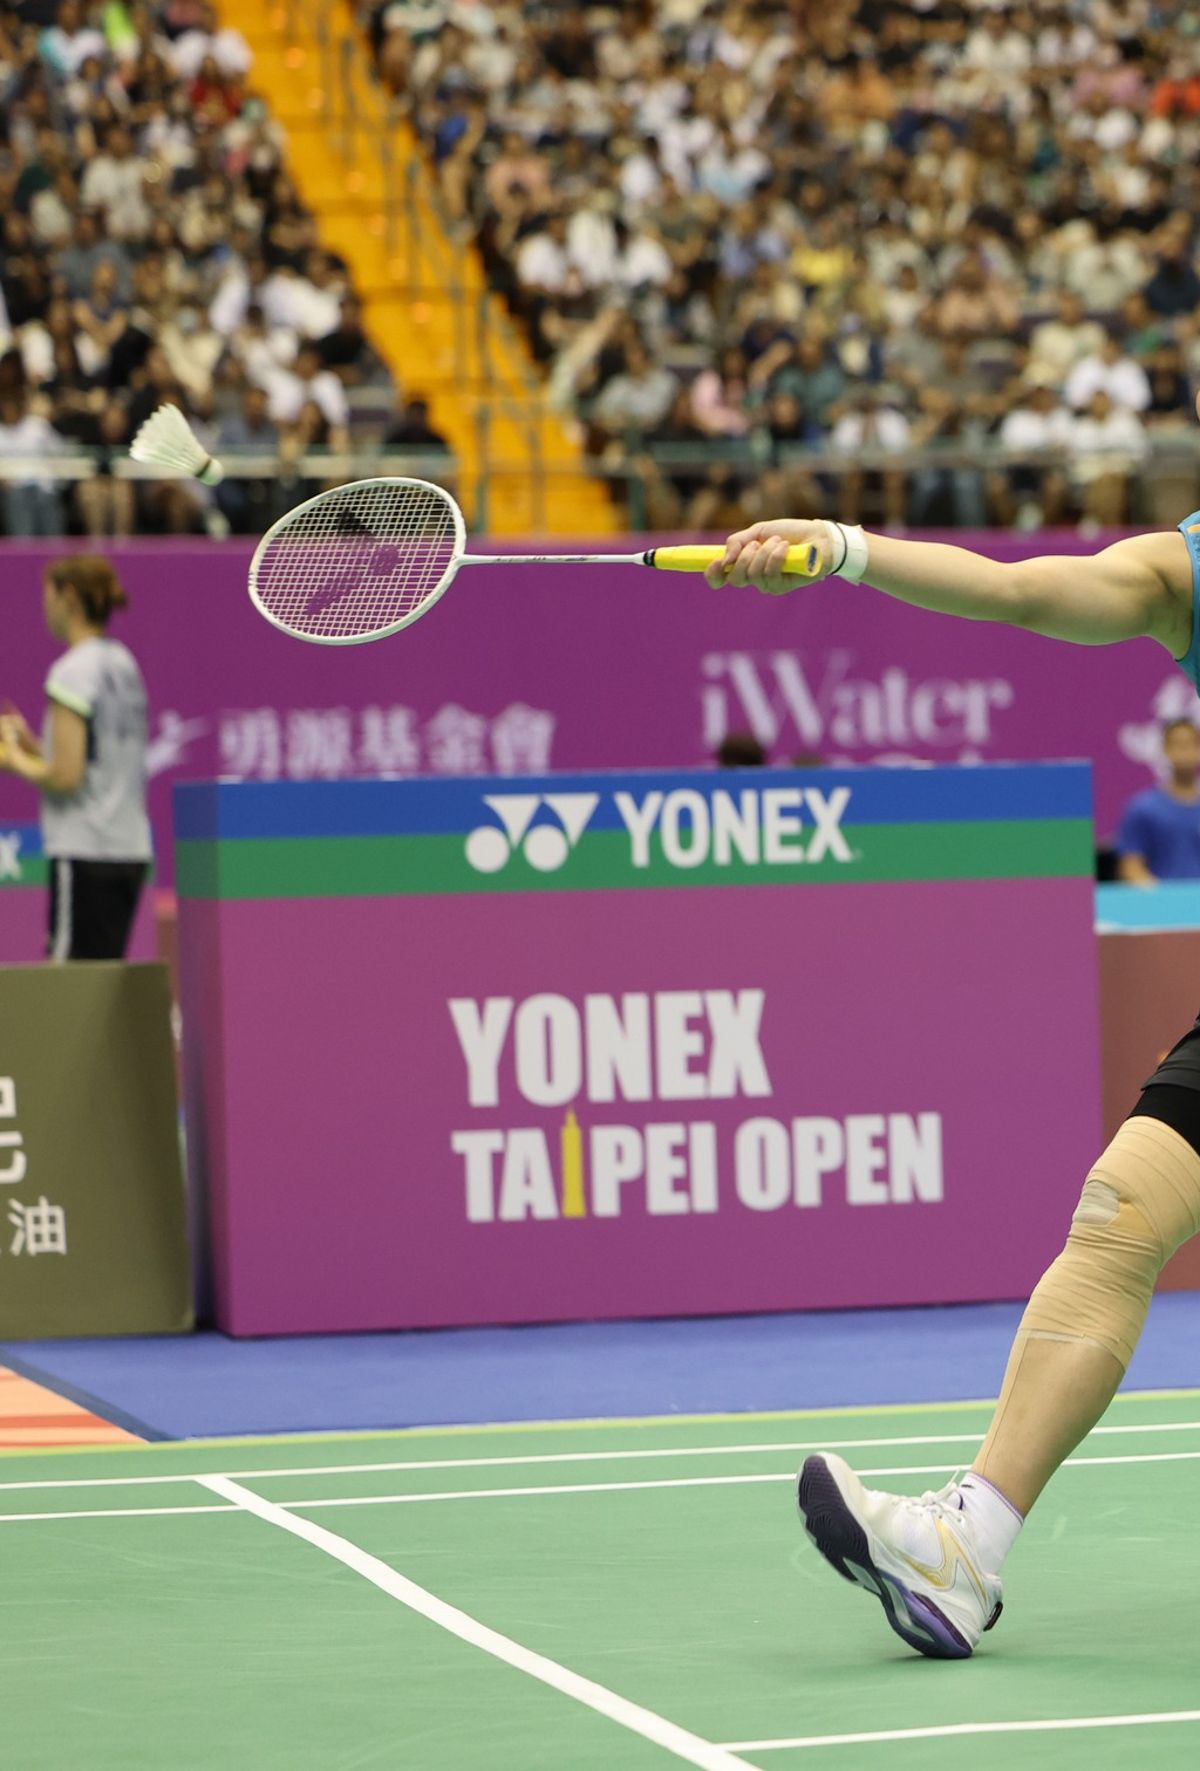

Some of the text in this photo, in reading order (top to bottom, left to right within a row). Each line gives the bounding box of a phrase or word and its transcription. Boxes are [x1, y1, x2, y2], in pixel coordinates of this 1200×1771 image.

[702, 649, 1014, 750] iWater
[613, 787, 853, 868] YONEX
[448, 989, 773, 1107] YONEX
[451, 1106, 945, 1223] TAIPEI OPEN
